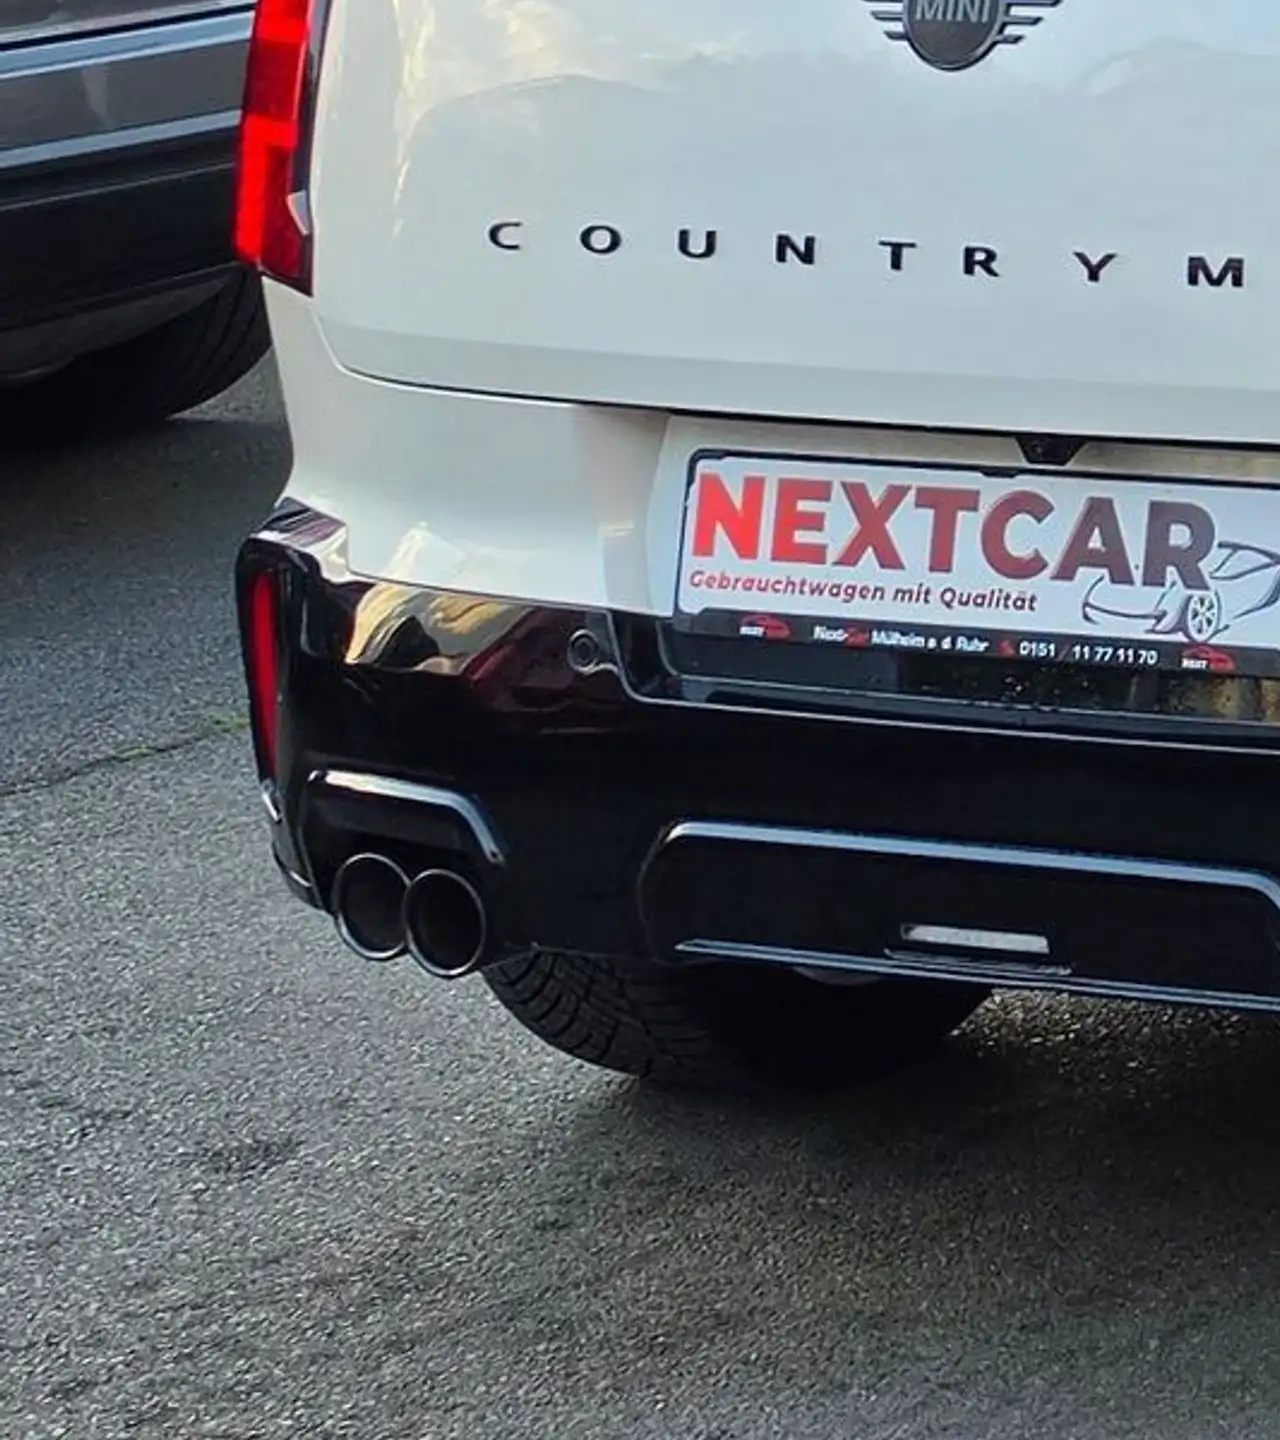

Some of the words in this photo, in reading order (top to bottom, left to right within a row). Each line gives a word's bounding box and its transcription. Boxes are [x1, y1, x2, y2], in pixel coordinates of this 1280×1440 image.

[691, 471, 1217, 592] NEXTCAR
[689, 570, 885, 604] Gebrauchtwagen
[892, 581, 930, 604] mit
[940, 586, 1037, 612] Qualität
[1019, 639, 1056, 658] 0151
